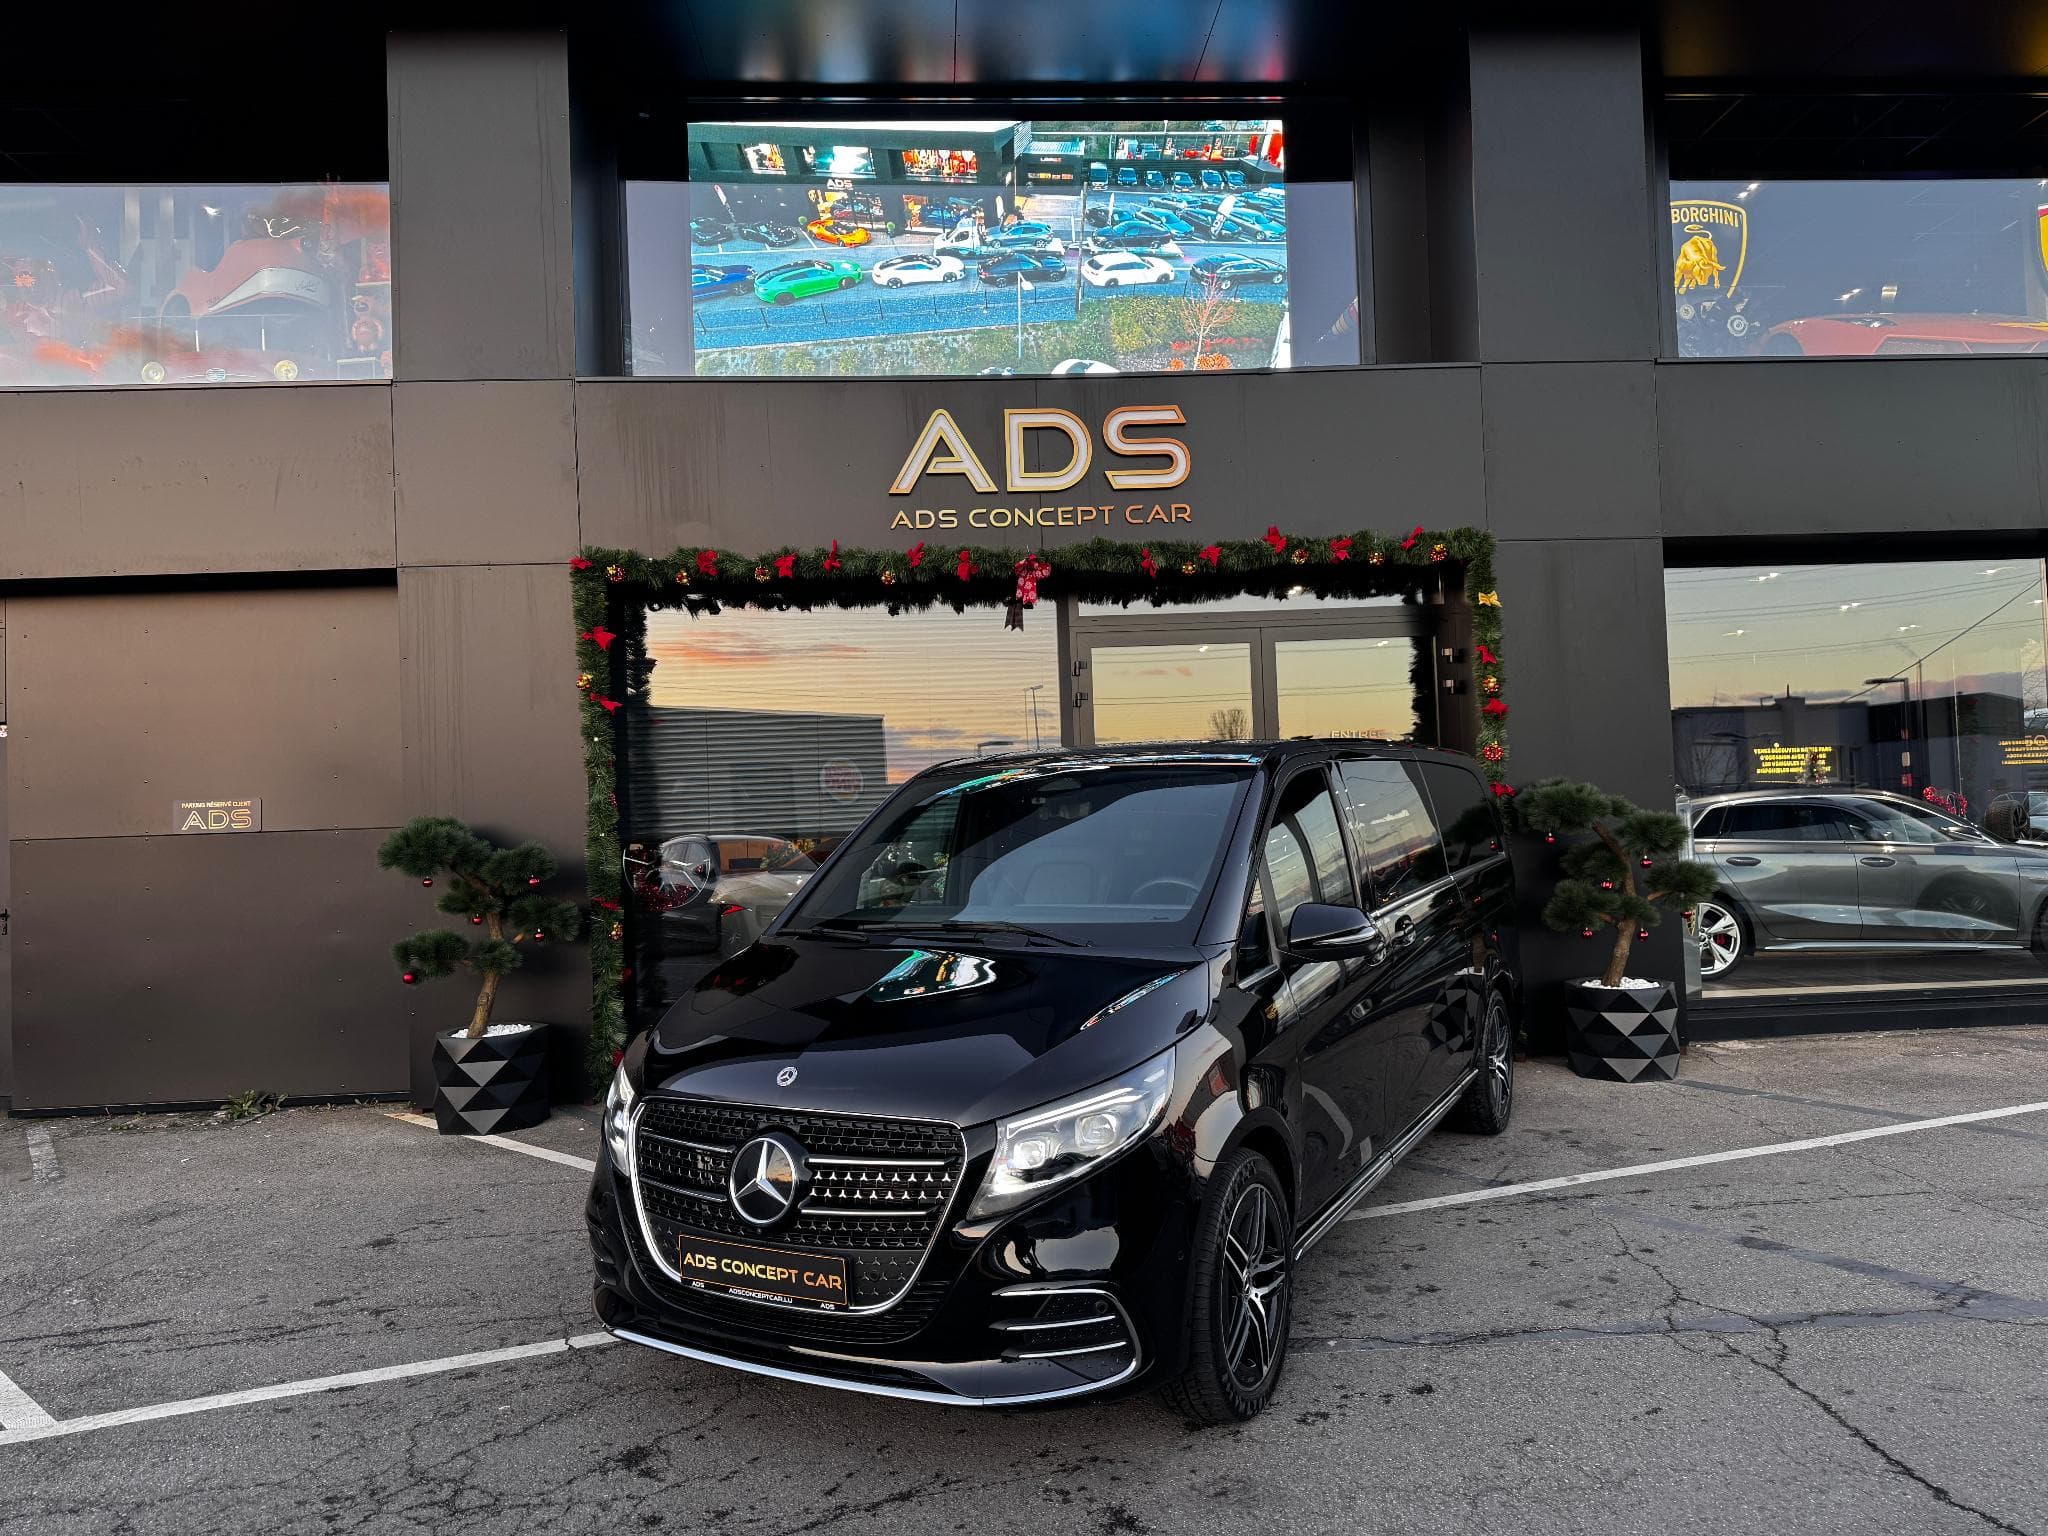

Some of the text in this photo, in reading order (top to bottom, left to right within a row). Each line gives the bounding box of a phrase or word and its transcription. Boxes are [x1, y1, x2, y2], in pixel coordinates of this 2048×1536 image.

[1671, 207, 1739, 228] BORGHINI
[888, 405, 1191, 493] ADS
[890, 503, 1192, 529] ADS CONCEPT CAR
[181, 809, 252, 831] ADS
[683, 1252, 843, 1290] ADS CONCEPT CAR
[728, 1287, 793, 1304] ADSCONCEPTCAR.LU
[820, 1302, 836, 1311] ADS
